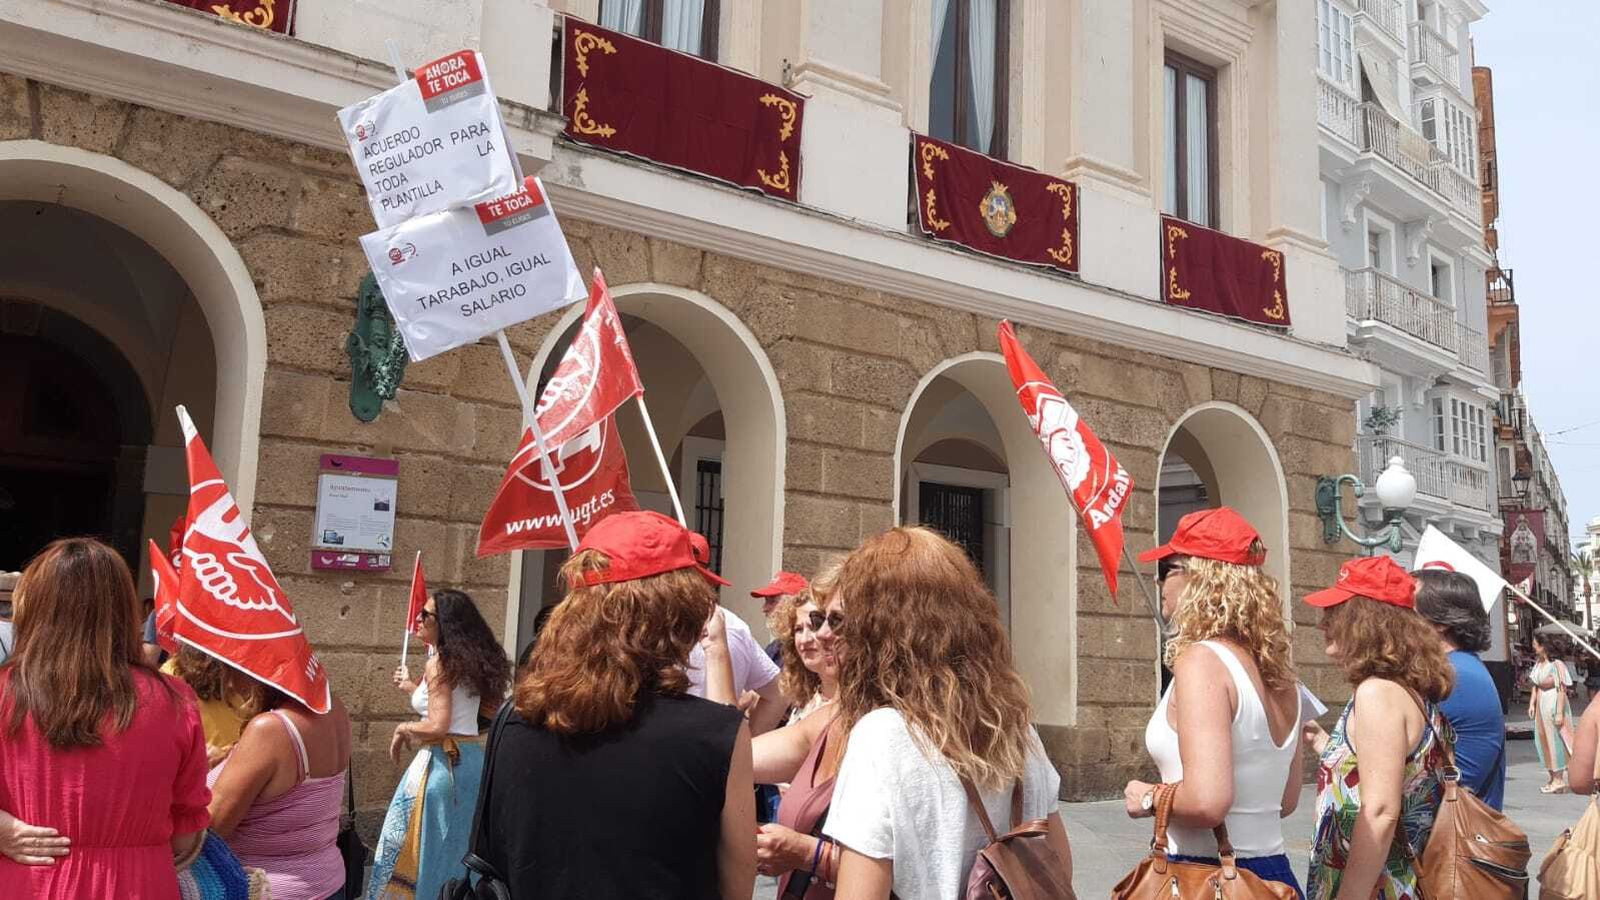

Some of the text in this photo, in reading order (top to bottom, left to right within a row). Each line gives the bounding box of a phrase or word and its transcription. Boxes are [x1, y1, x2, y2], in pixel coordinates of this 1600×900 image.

[424, 56, 467, 80] AHORA
[428, 69, 471, 93] TE TOCA
[363, 126, 421, 159] ACUERDO
[369, 121, 490, 177] REGULADOR PARA
[477, 141, 496, 157] LA
[374, 176, 408, 195] TODA
[381, 179, 444, 211] PLANTILLA
[488, 203, 504, 217] TE
[504, 194, 533, 211] TOCA
[451, 245, 512, 276] A IGUAL
[417, 253, 551, 311] TARABAJO, IGUAL
[460, 283, 527, 317] SALARIO
[505, 487, 615, 536] wwwugt.es
